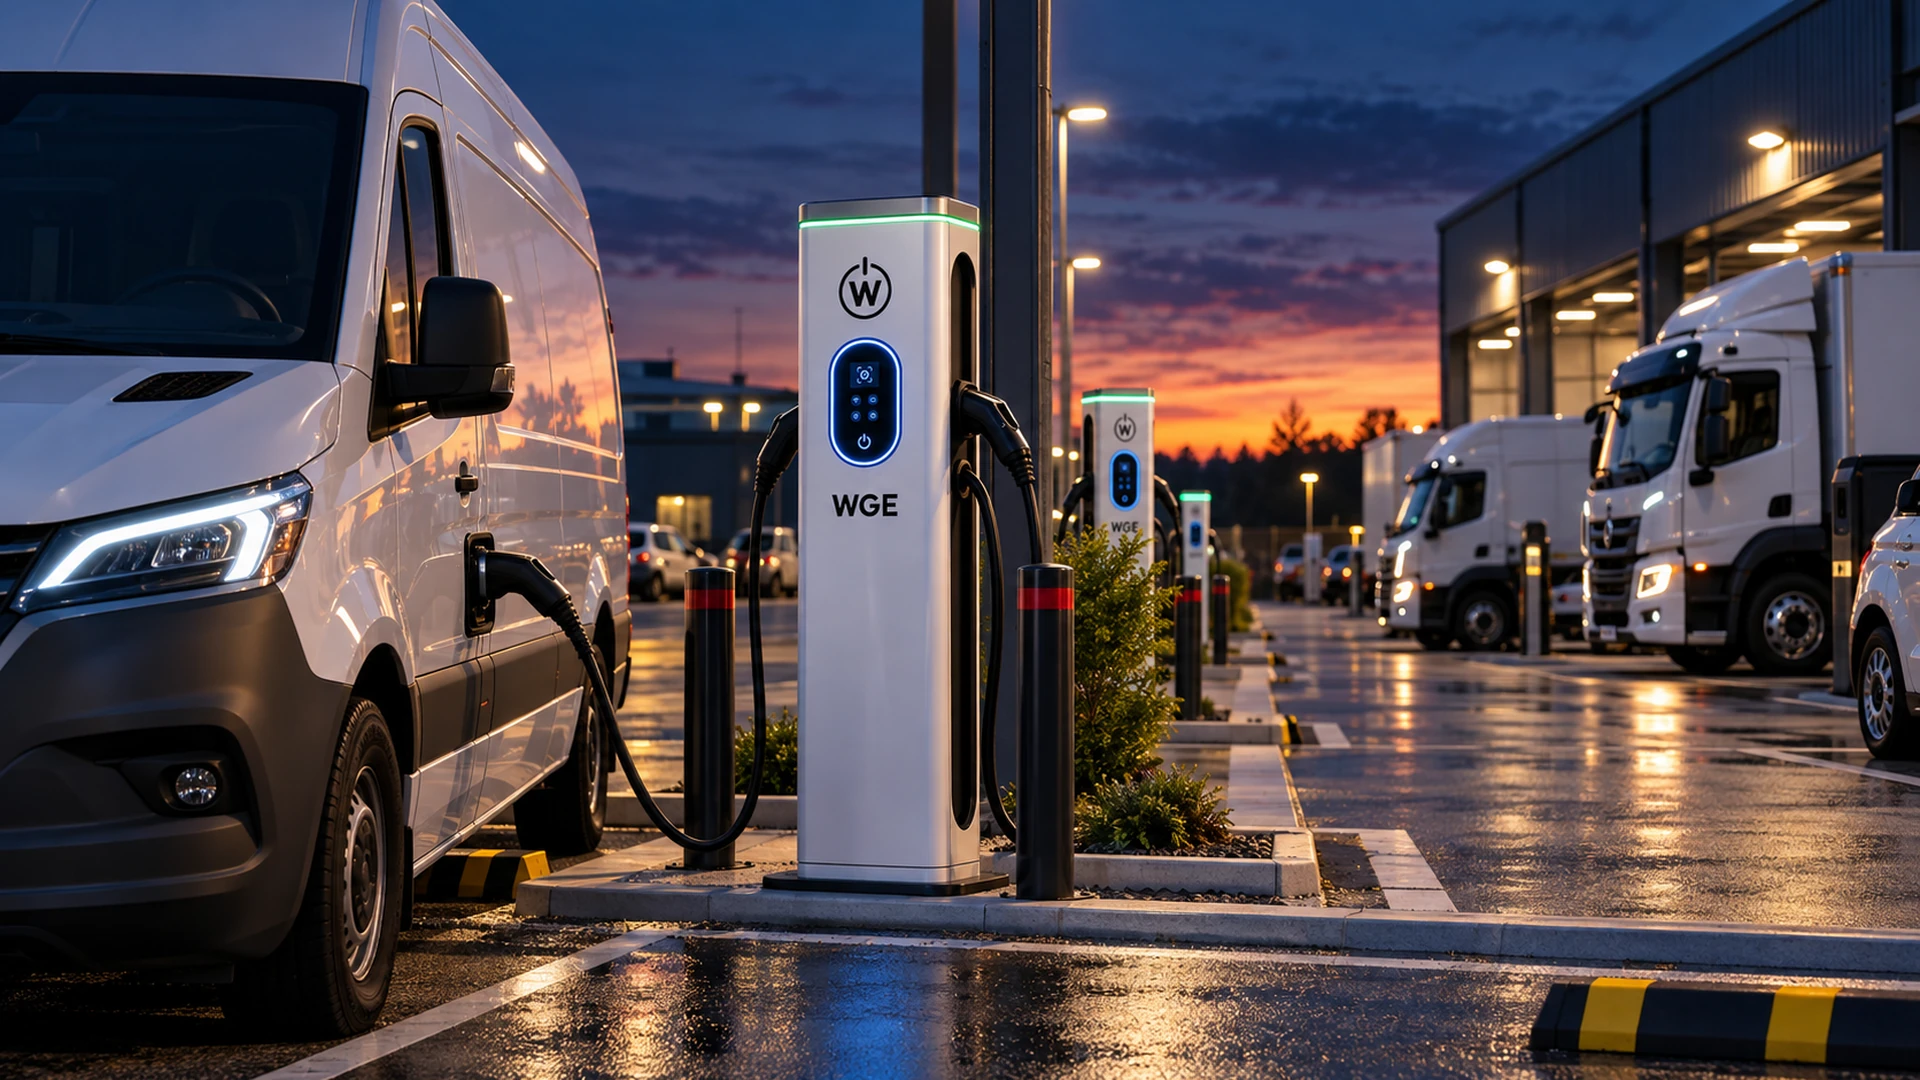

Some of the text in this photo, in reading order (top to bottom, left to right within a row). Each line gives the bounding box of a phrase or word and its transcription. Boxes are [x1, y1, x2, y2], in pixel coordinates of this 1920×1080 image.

[849, 280, 882, 307] W
[1118, 424, 1132, 437] W
[832, 493, 899, 517] WGE
[1111, 521, 1139, 533] WGE
